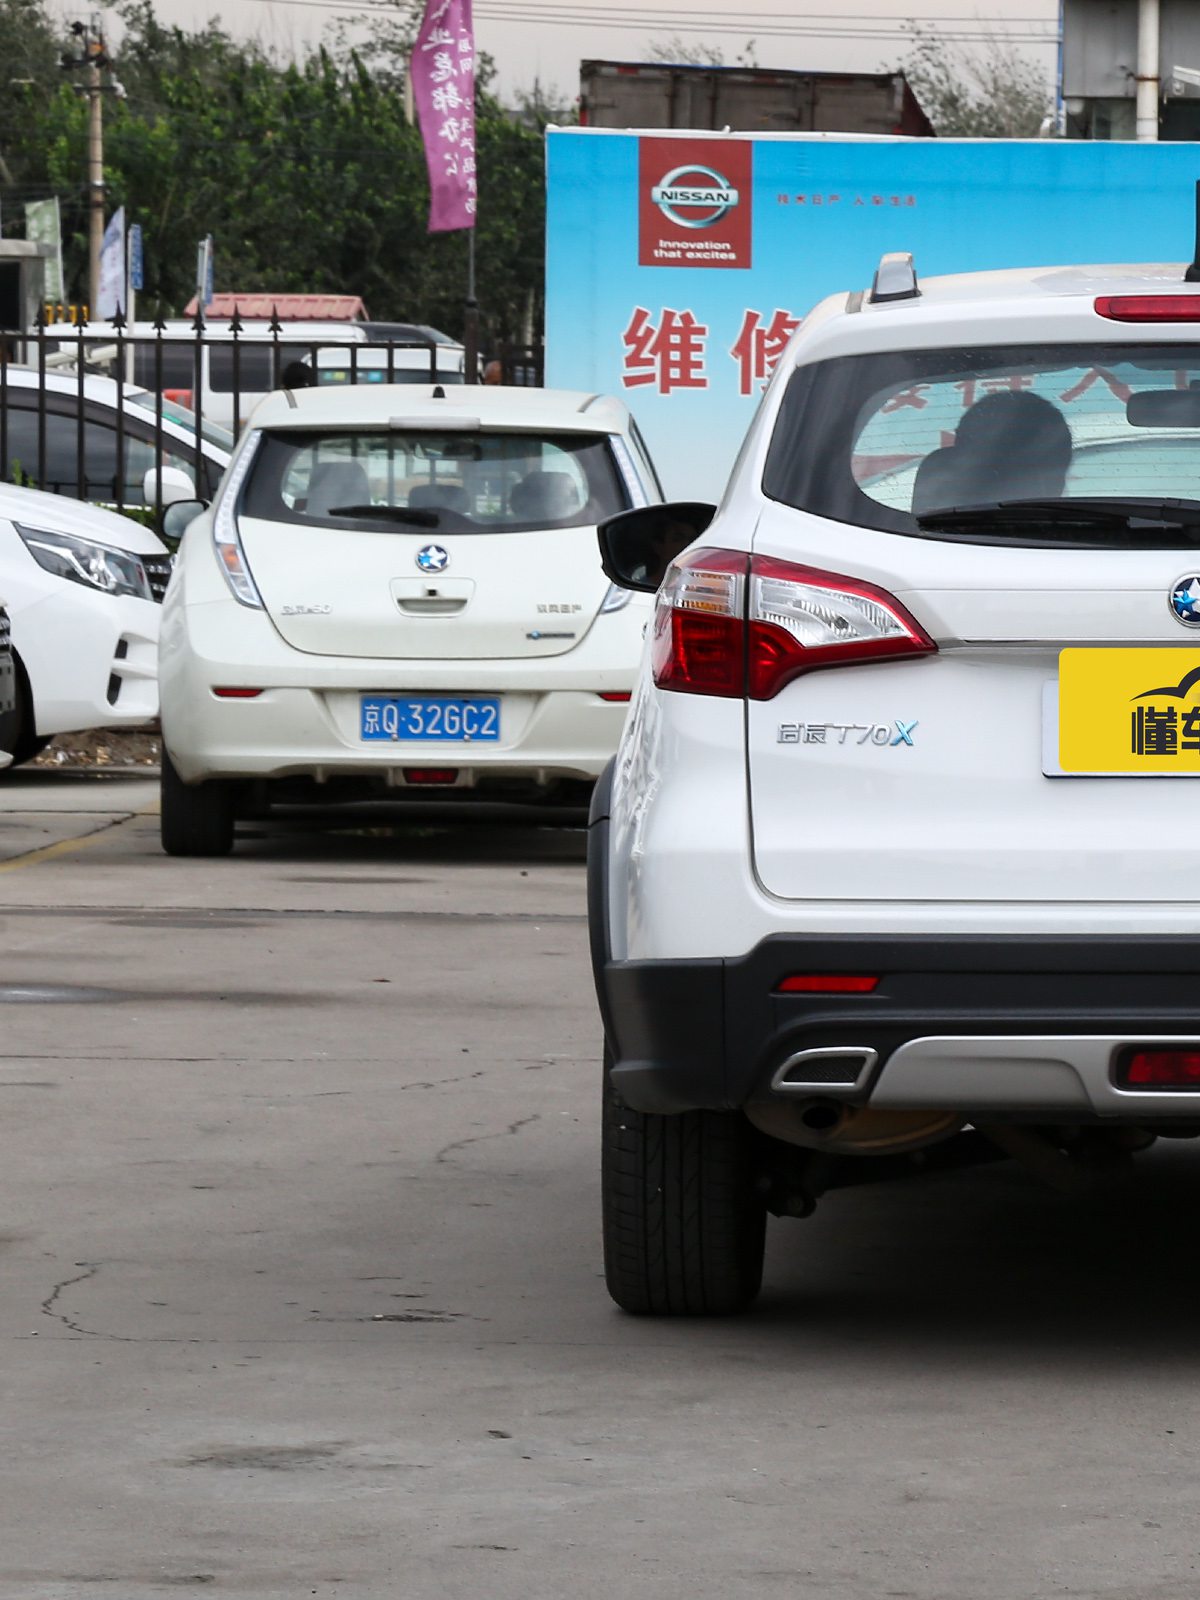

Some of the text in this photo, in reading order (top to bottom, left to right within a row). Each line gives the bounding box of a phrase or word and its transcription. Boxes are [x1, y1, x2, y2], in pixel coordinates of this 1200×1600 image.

[661, 190, 730, 202] NISSAN
[659, 240, 731, 250] Innovation
[653, 249, 737, 260] that excites
